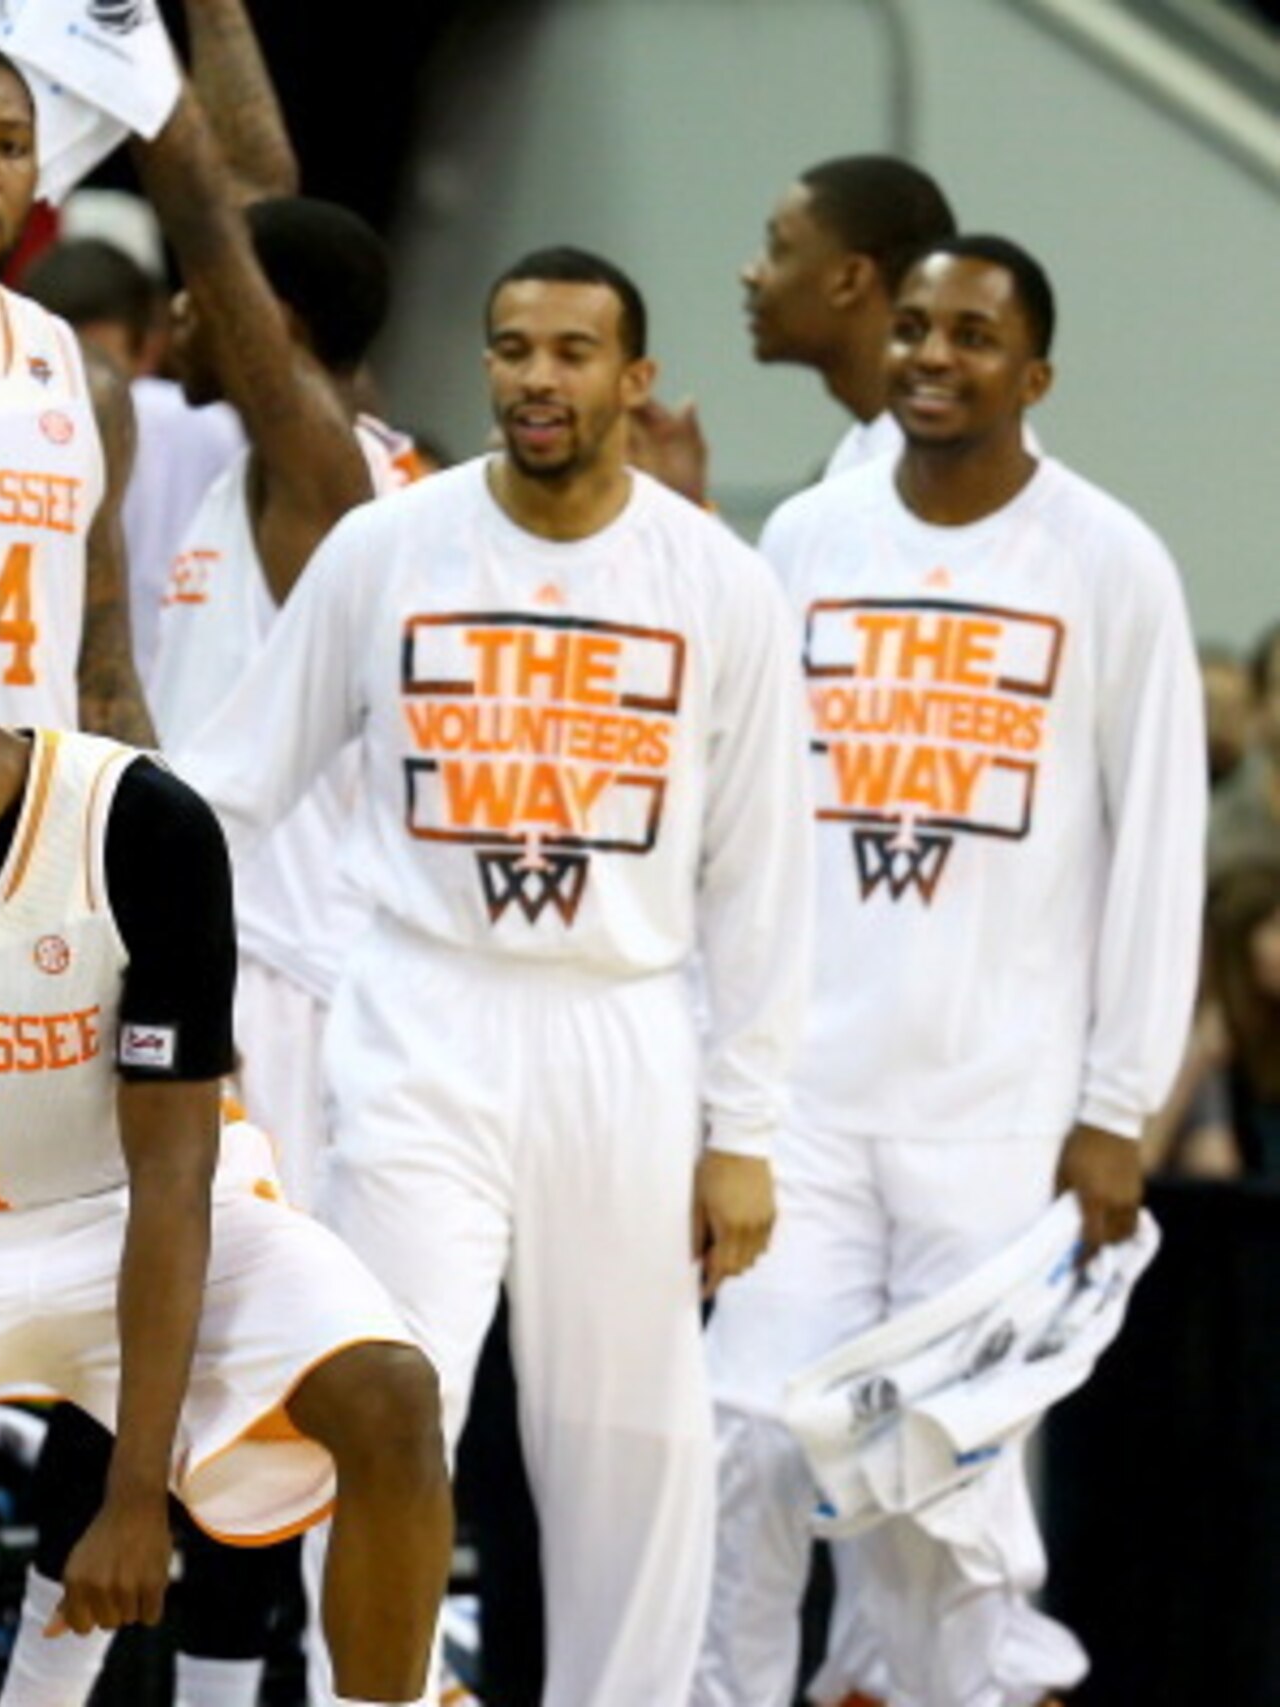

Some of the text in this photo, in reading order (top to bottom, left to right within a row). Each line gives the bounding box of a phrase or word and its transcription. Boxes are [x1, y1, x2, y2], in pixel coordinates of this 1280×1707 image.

[466, 630, 621, 706] THE
[856, 614, 1002, 686] THE
[405, 702, 673, 768] VOLUNTEERS
[444, 761, 615, 833] WAY
[831, 742, 993, 816] WAY
